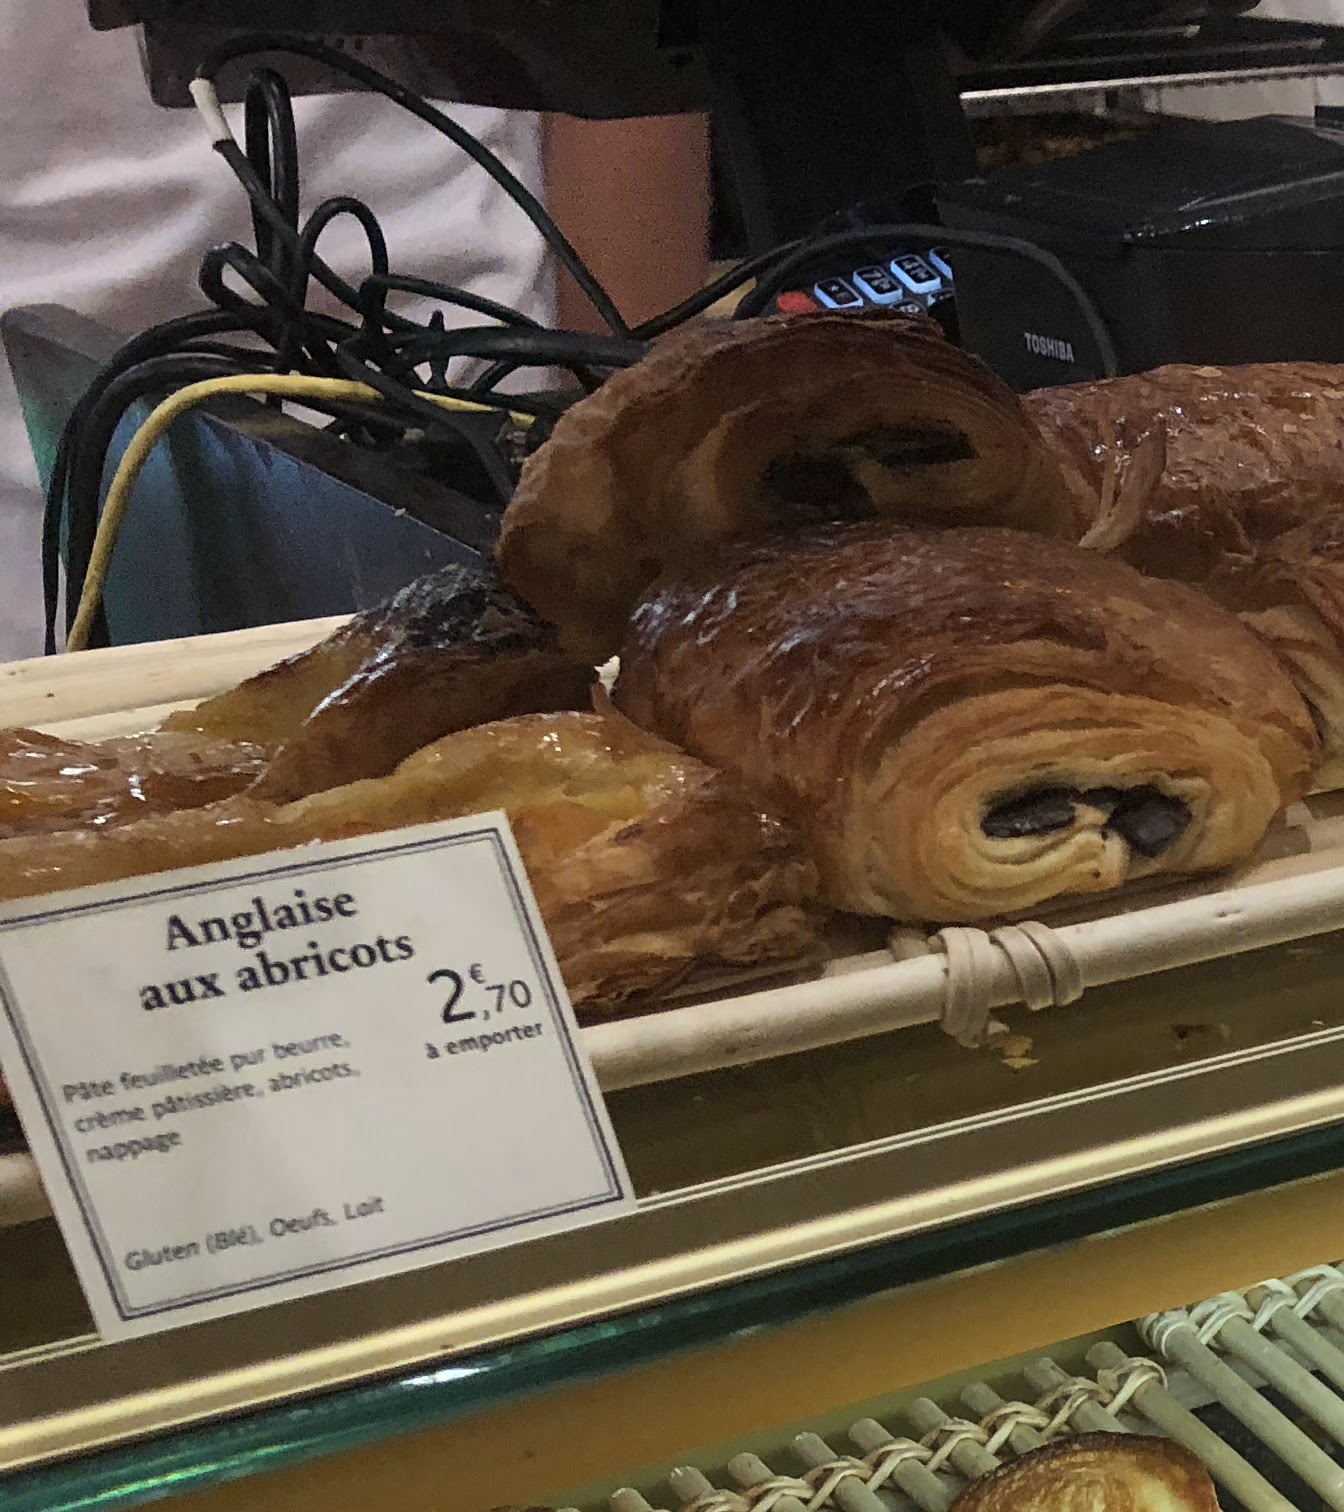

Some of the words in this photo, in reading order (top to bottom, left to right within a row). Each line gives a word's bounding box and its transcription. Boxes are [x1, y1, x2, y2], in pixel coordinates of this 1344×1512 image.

[1024, 331, 1075, 364] TOSHIBA
[164, 889, 359, 952] Anglaise
[140, 971, 227, 1012] aux
[237, 931, 416, 994] abricots
[62, 1080, 115, 1103] Pâte
[119, 1057, 224, 1091] feuilletée
[229, 1049, 265, 1073] pur
[271, 1033, 351, 1060] beurre,
[424, 1041, 439, 1061] à
[445, 1020, 544, 1059] emporter
[75, 1107, 147, 1133] crème
[268, 1063, 361, 1092] abricots,
[86, 1131, 183, 1163] nappage
[124, 1241, 201, 1271] Gluten
[343, 1196, 387, 1221] Lait
